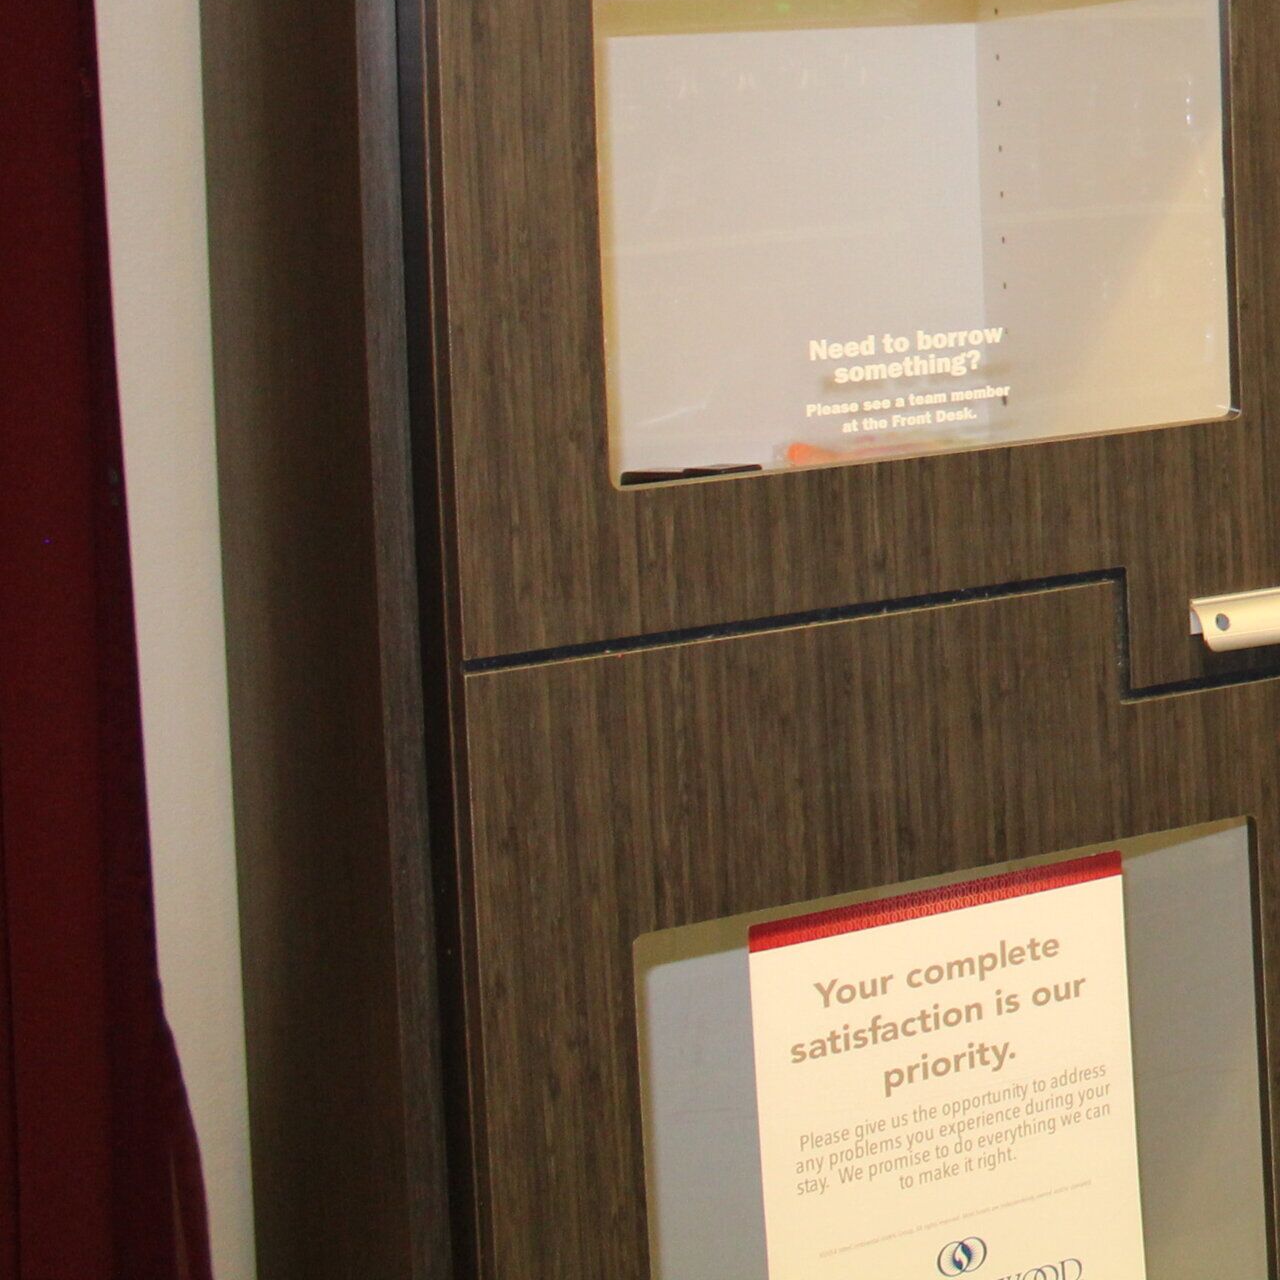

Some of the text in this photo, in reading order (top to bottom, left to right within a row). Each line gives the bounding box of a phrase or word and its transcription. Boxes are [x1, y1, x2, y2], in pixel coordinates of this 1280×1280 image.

[809, 327, 1003, 361] Need to borrow
[834, 349, 981, 384] something?
[806, 384, 1010, 418] Please see a team member
[841, 406, 978, 434] at the Front Desk.
[813, 937, 1060, 1009] Your complete
[790, 977, 1086, 1064] satisfaction is our
[883, 1041, 1017, 1098] priority.
[796, 1082, 1111, 1174] any problems you experience during your
[800, 1064, 1107, 1152] Please give us the opportunity to address
[796, 1102, 1111, 1197] stay. We promise to do everything we can
[899, 1147, 1018, 1191] to make it right.
